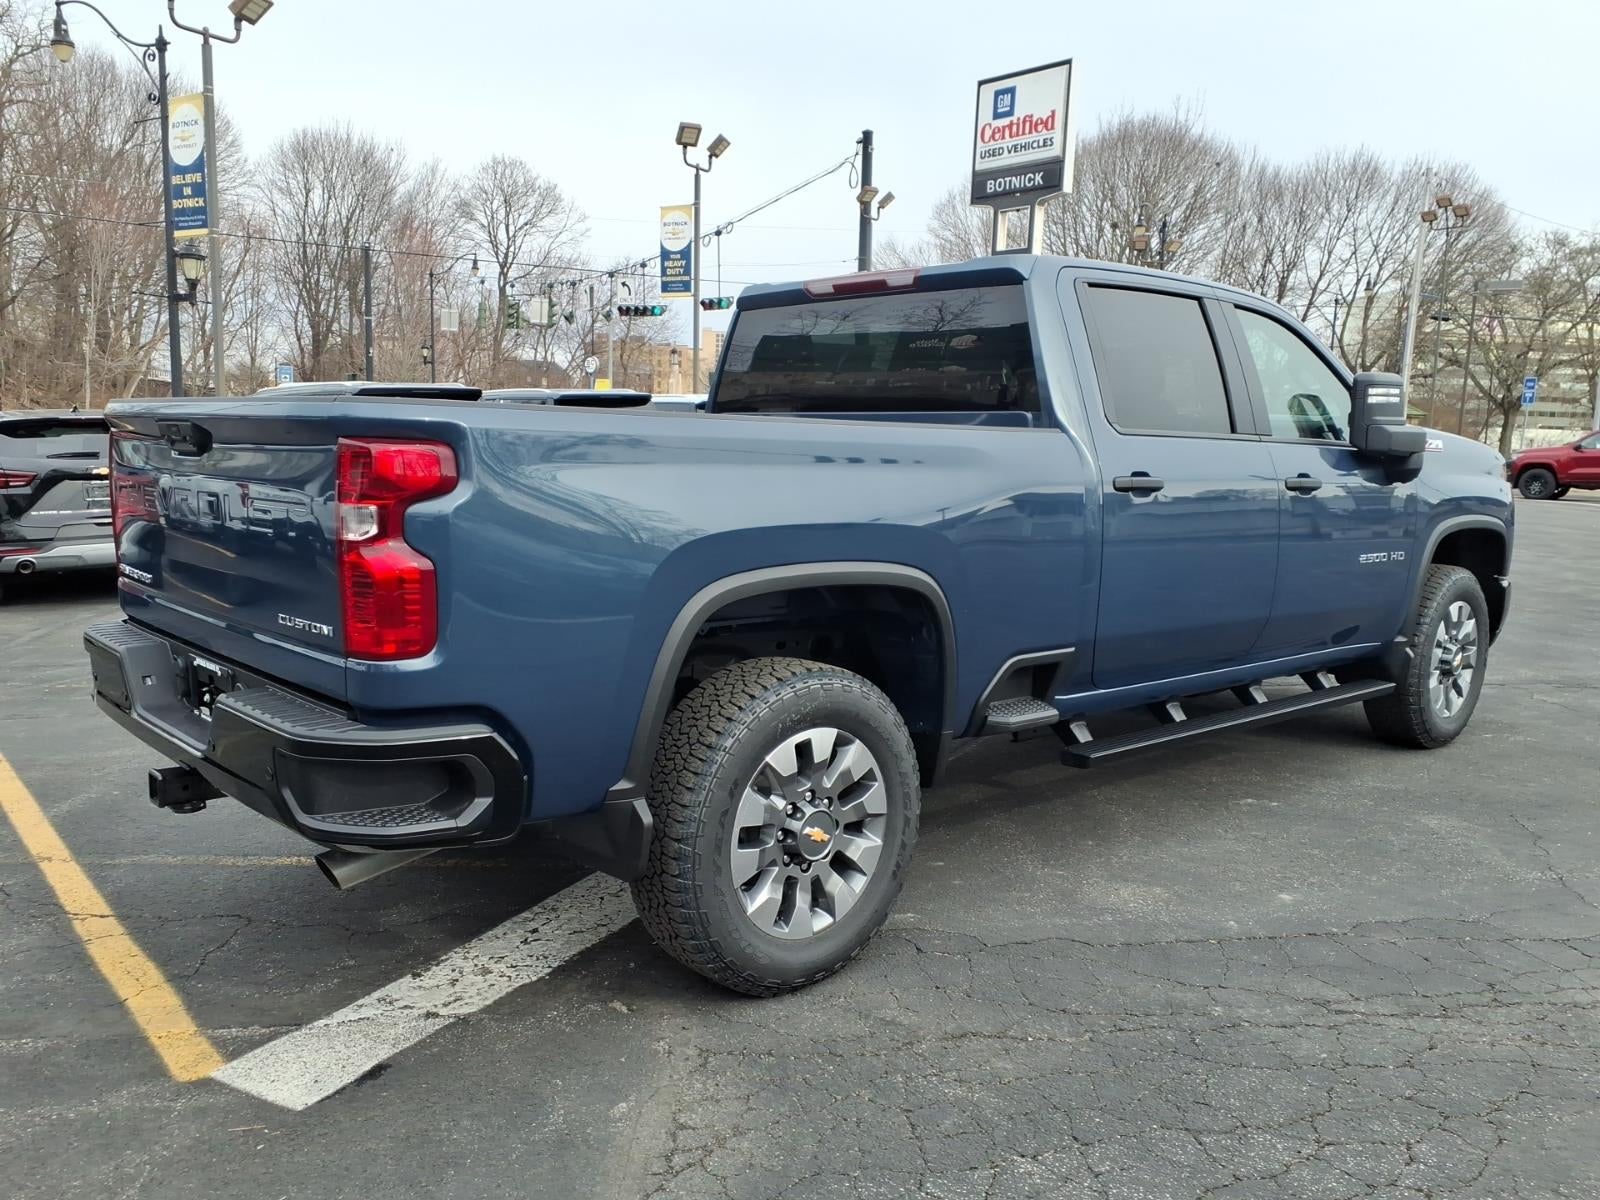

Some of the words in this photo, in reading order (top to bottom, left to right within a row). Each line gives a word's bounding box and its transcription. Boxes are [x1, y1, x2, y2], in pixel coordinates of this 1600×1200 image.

[997, 93, 1012, 108] GM
[172, 119, 199, 129] BOTNICK
[980, 109, 1057, 144] Certified
[980, 146, 1005, 160] USED
[1006, 136, 1055, 155] VEHICLES
[171, 173, 202, 185] BELIEVE
[986, 171, 1044, 193] BOTNICK
[183, 186, 192, 196] IN
[172, 198, 205, 209] BOTNICK
[1359, 552, 1388, 564] 2500
[1390, 551, 1405, 561] HD
[277, 613, 334, 638] CUSTOM
